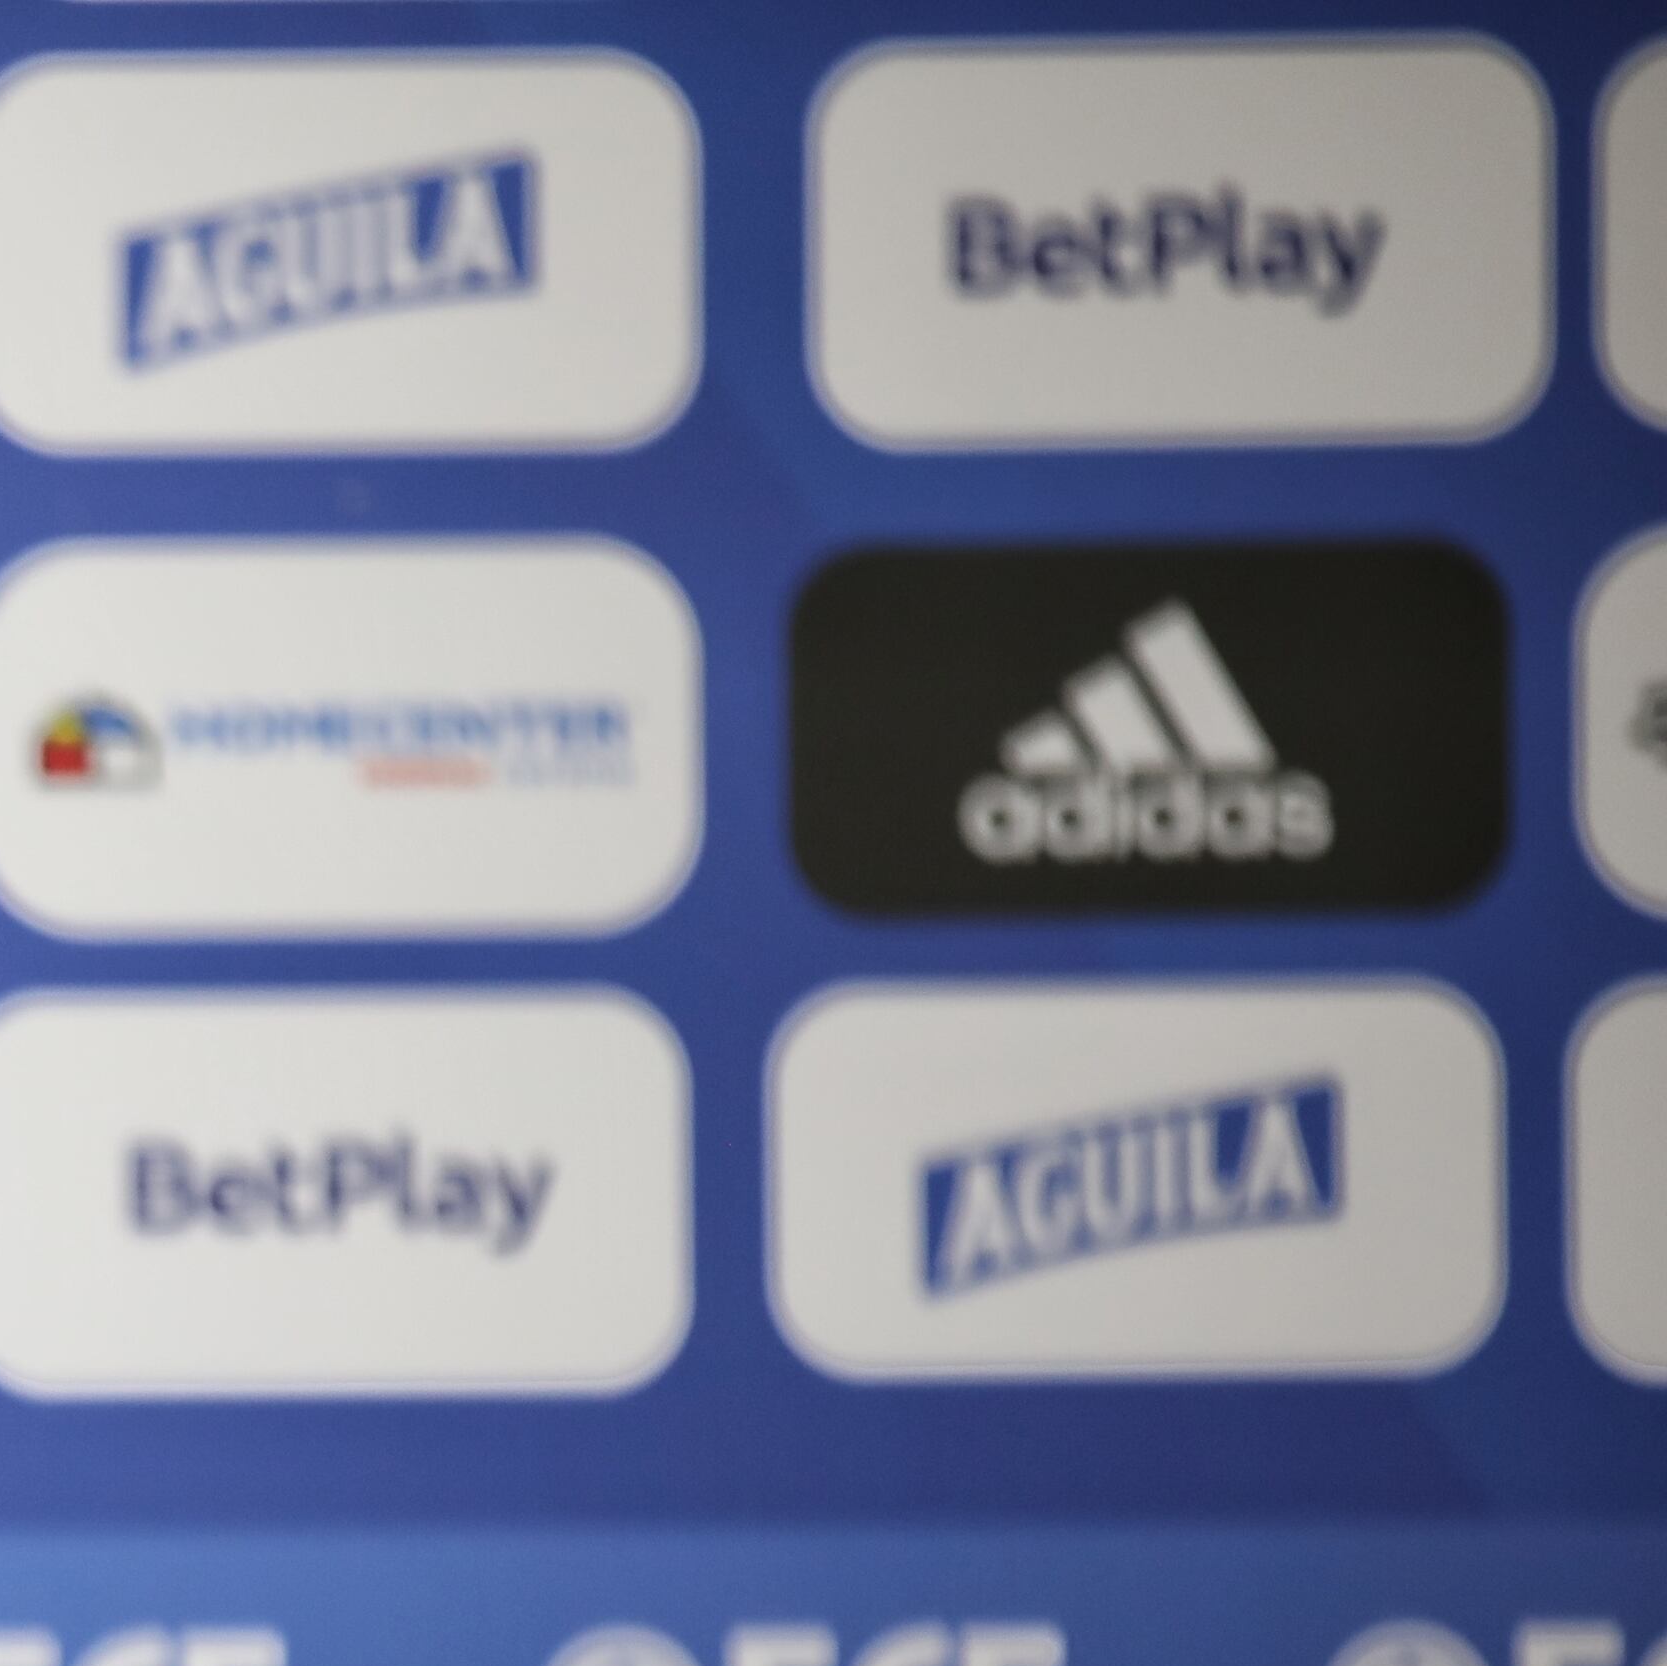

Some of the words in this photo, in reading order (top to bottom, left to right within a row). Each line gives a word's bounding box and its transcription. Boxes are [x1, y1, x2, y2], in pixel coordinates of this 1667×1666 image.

[135, 165, 522, 345] AGUILA
[946, 180, 1386, 317] BetPlay
[958, 765, 1337, 862] adidas
[124, 1131, 555, 1258] BetPlay
[941, 1092, 1327, 1285] AGUILA
